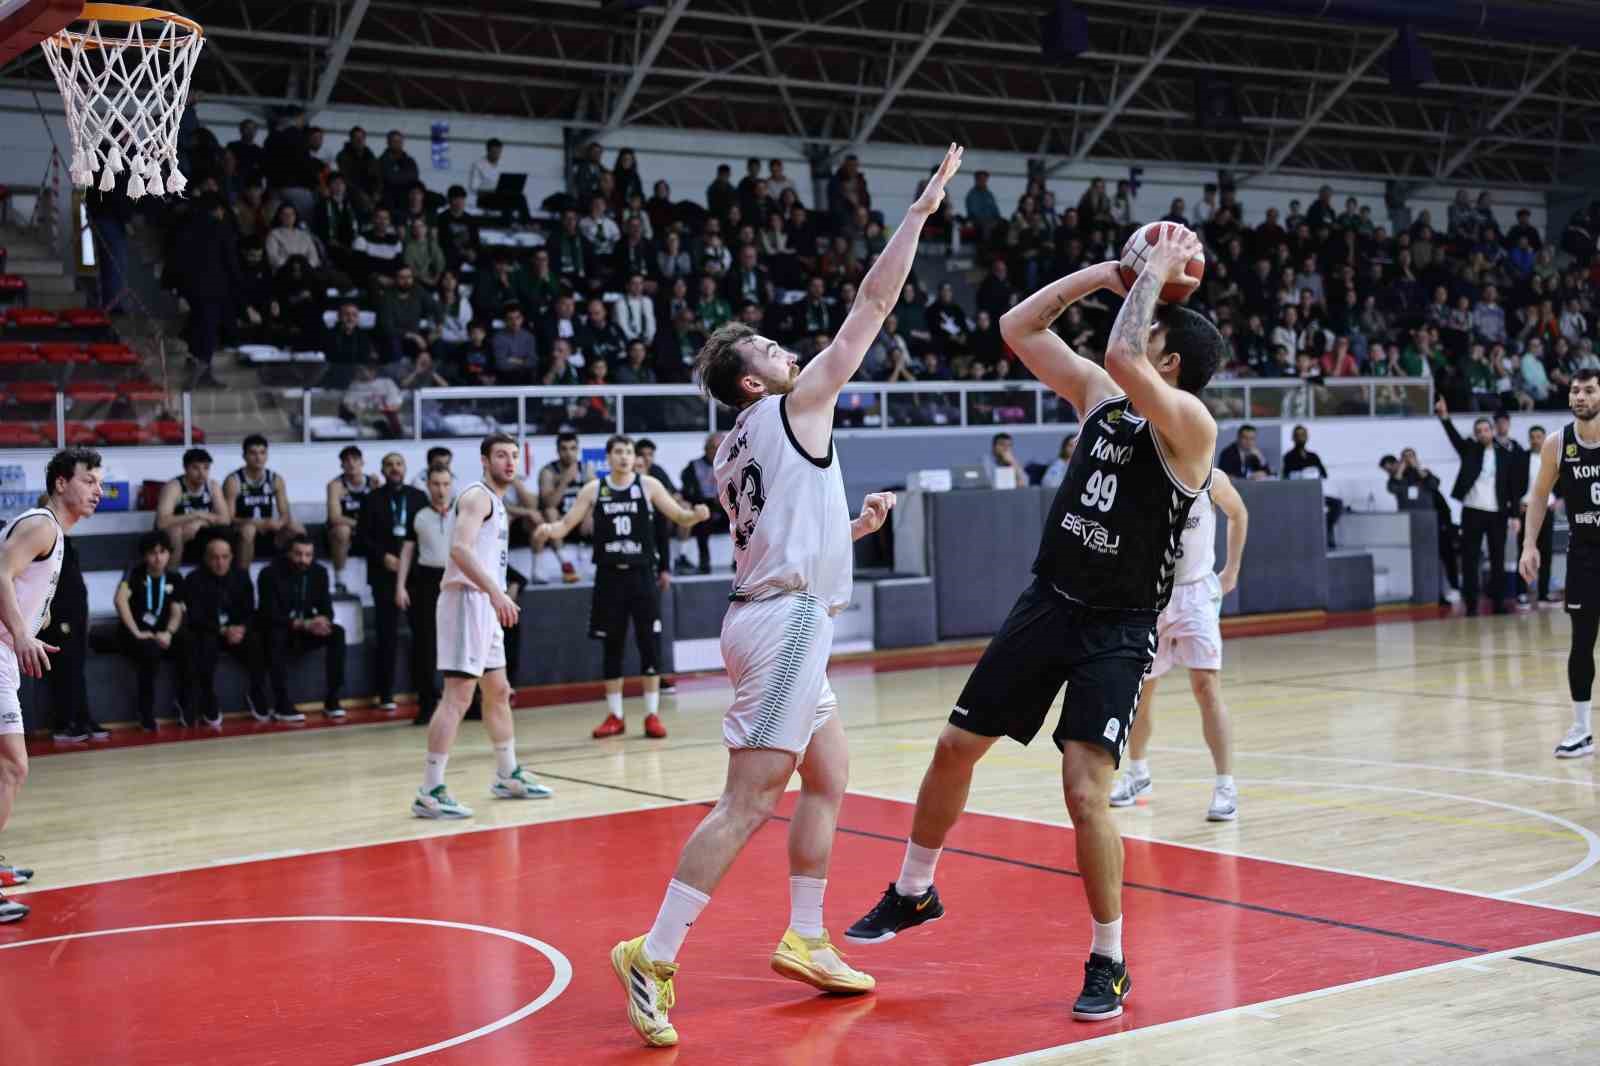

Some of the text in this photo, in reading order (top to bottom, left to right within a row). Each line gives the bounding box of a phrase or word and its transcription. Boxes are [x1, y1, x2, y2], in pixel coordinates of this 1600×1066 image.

[1573, 465, 1600, 479] KON
[1081, 470, 1117, 512] 99
[613, 515, 632, 535] 10
